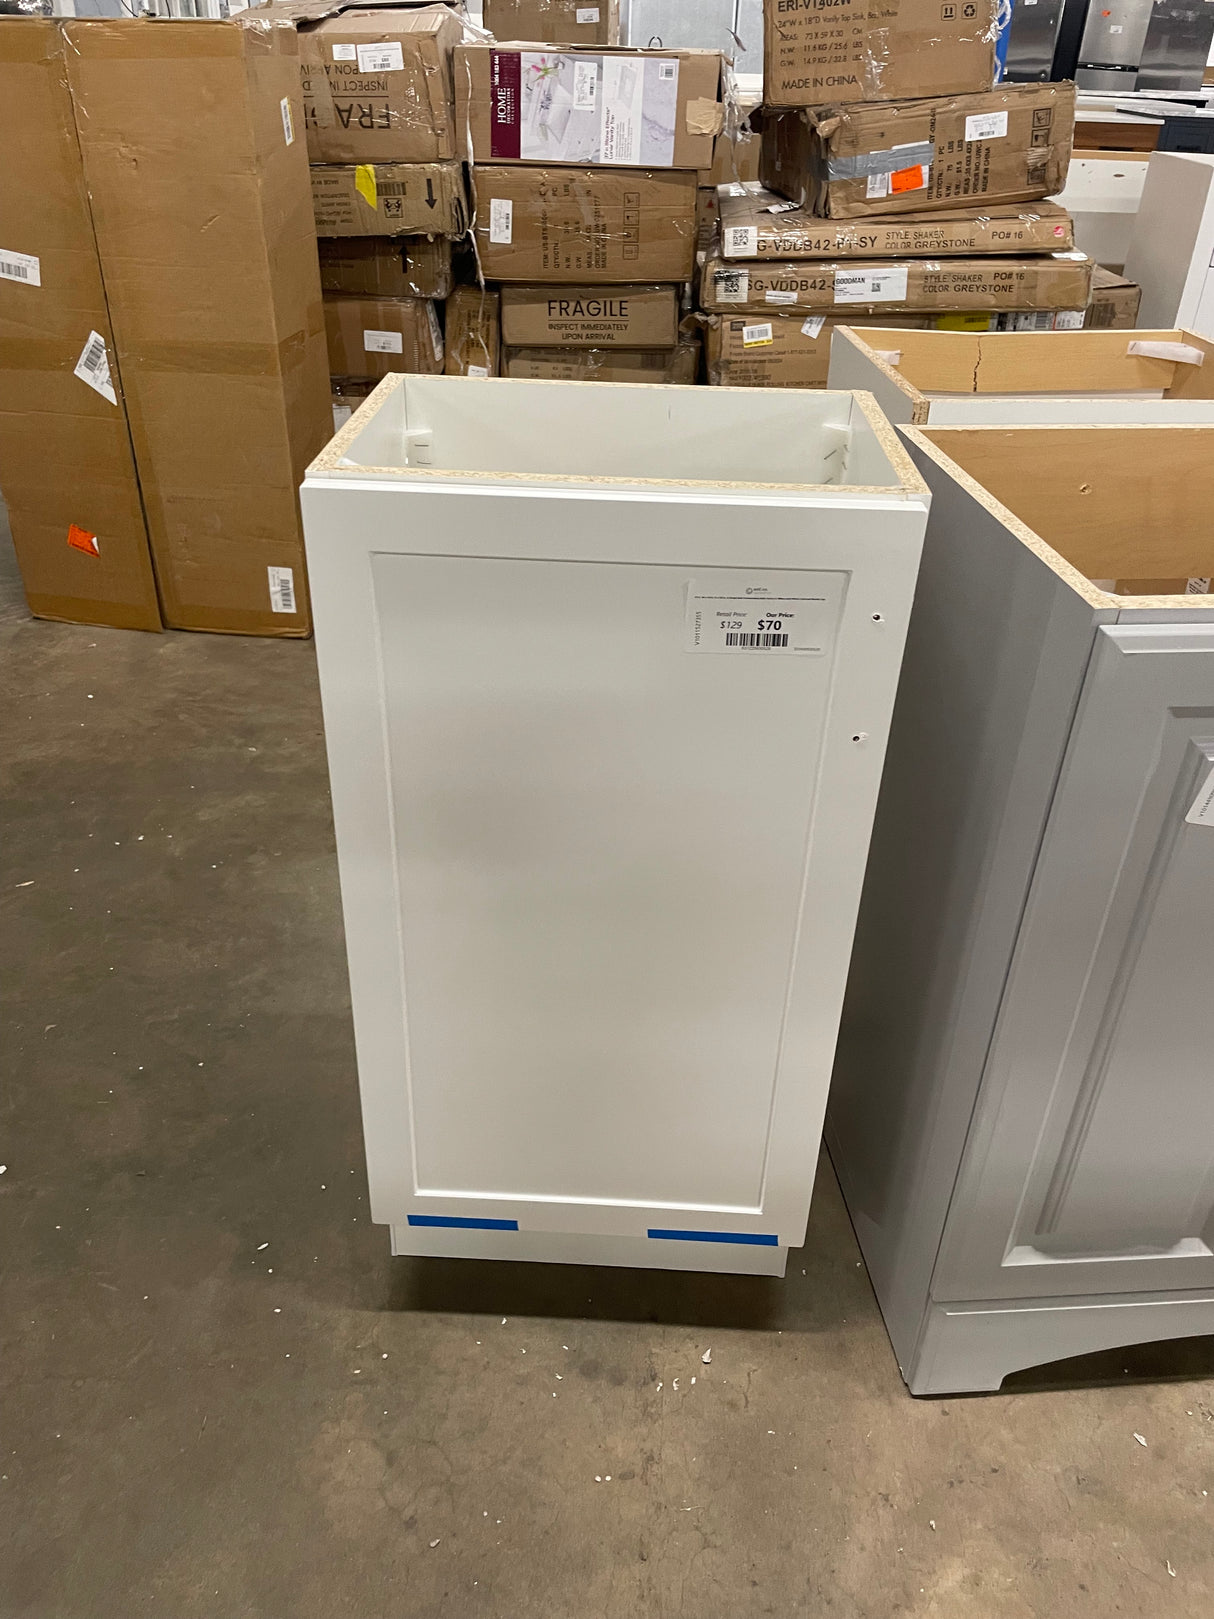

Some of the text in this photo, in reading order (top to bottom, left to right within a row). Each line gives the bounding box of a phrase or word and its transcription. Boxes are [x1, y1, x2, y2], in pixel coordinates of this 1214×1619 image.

[344, 80, 388, 92] INSPECT
[782, 75, 858, 90] MADE IN CHINA
[497, 88, 506, 123] HOME
[938, 146, 945, 155] PC
[913, 230, 945, 239] SHAKER
[991, 231, 1023, 240] PO# 16
[915, 239, 976, 249] GREYSTONE
[952, 274, 983, 282] SHAKER
[994, 272, 1014, 281] PO#
[954, 284, 1014, 293] GREYSTONE
[548, 300, 629, 316] FRAGILE
[720, 621, 742, 629] $129
[757, 620, 782, 631] $70
